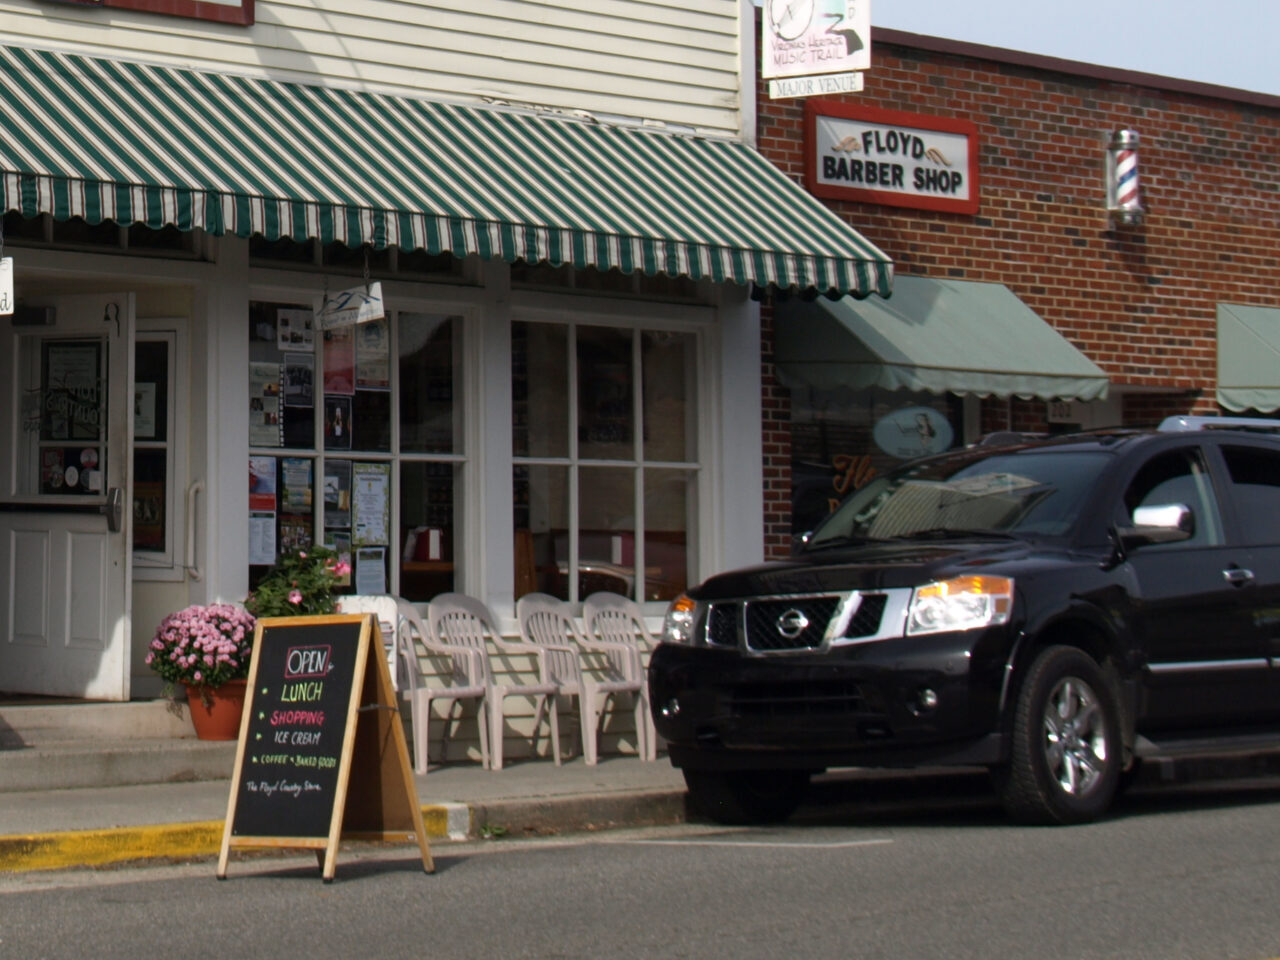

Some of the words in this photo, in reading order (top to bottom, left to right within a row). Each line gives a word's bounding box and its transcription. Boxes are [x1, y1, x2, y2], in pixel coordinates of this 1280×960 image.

[773, 50, 807, 67] MUSIC
[809, 46, 844, 64] TRAIL
[776, 79, 814, 97] MAJOR
[818, 75, 857, 93] VENUE
[861, 130, 925, 159] FLOYD
[822, 155, 904, 187] BARBER
[913, 167, 963, 194] SHOP
[288, 649, 327, 674] OPEN
[281, 682, 323, 702] LUNCH
[270, 710, 325, 726] SHOPPING
[274, 731, 289, 744] ICE
[291, 731, 321, 745] CREAM
[260, 754, 288, 765] COFFEE
[295, 755, 317, 767] BAKED
